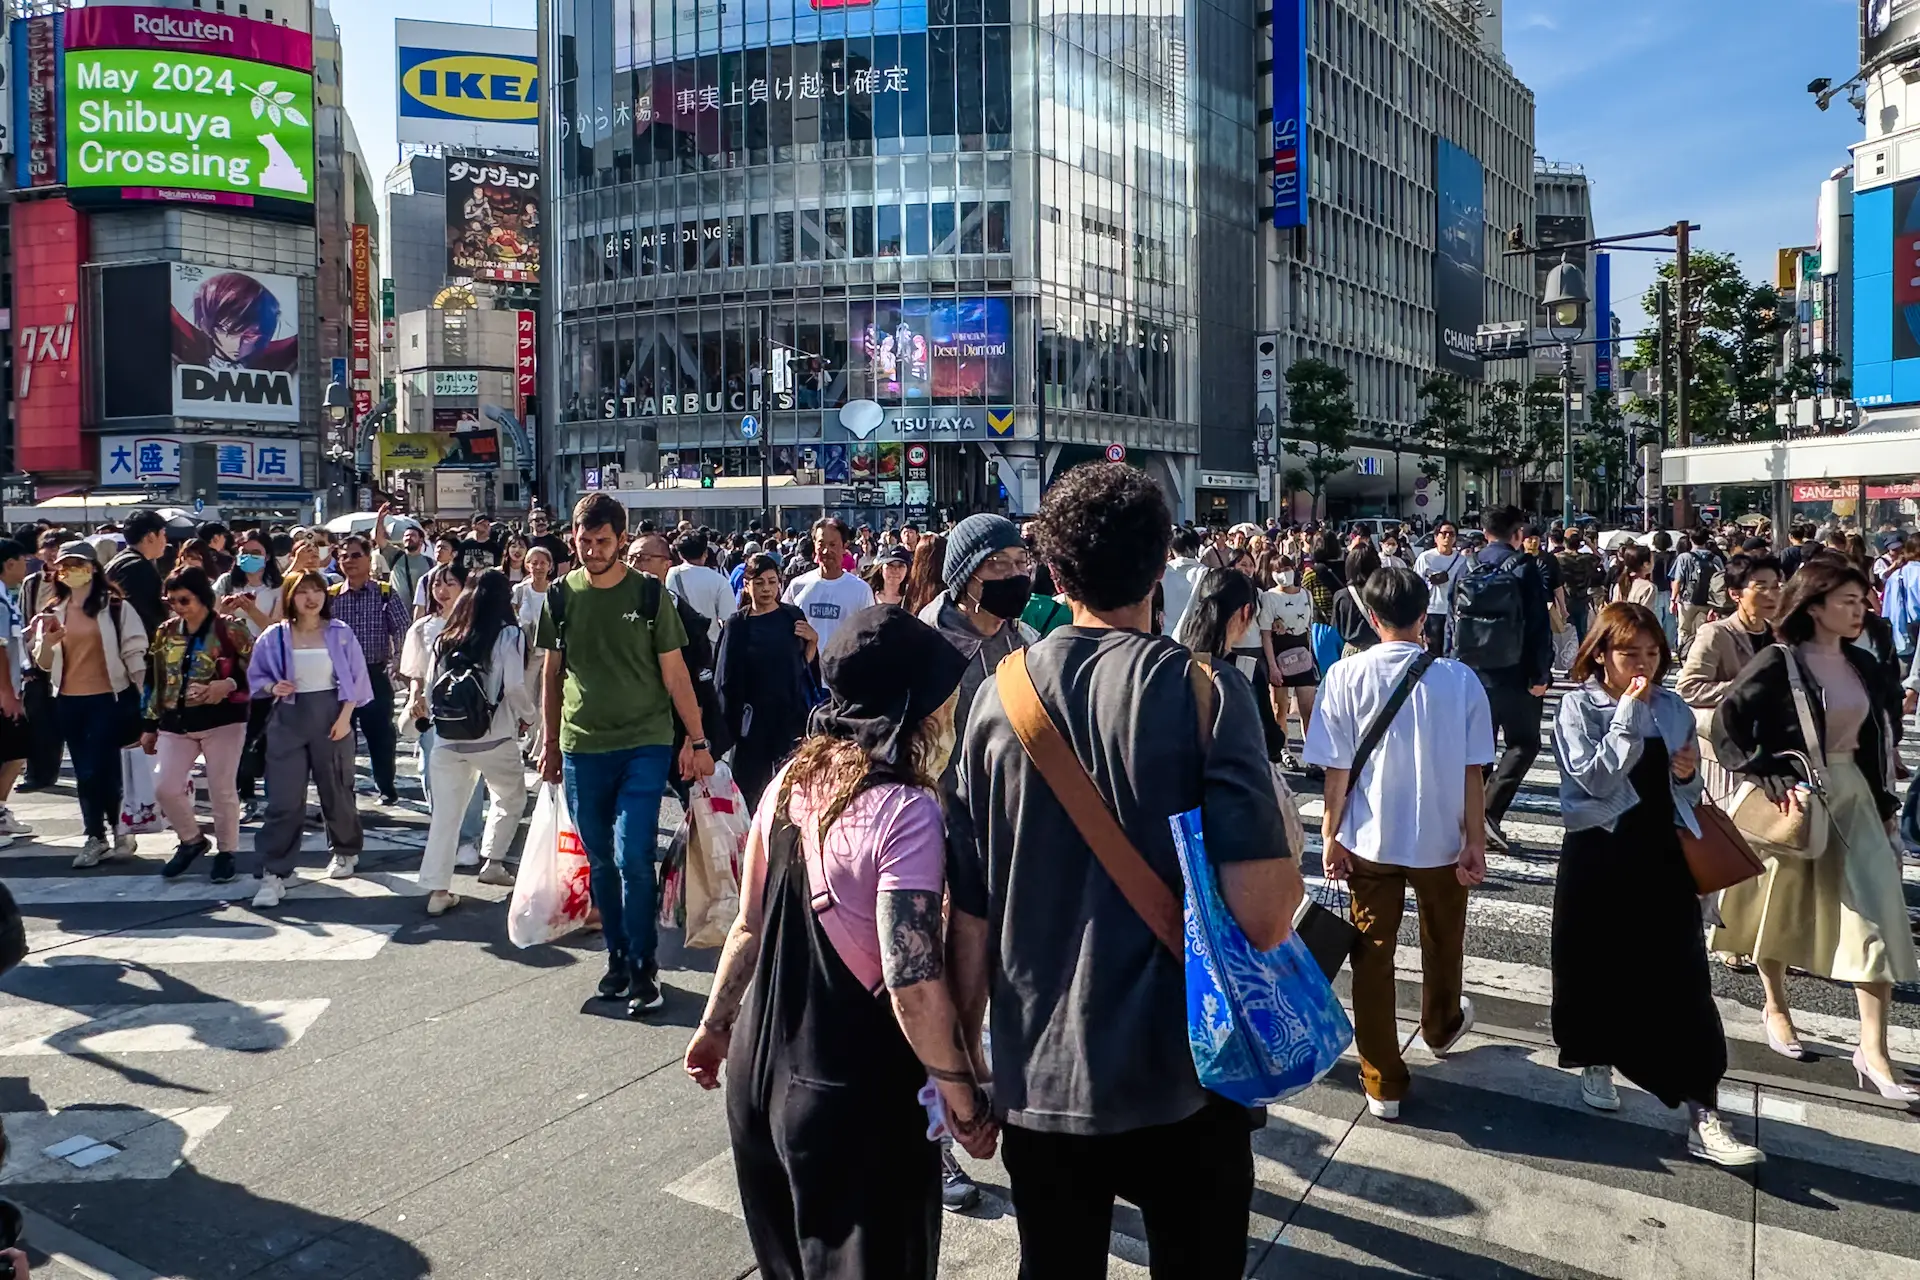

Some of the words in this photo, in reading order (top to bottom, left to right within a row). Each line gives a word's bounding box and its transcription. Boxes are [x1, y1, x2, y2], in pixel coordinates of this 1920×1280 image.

[134, 13, 234, 43] Rakuten
[77, 62, 139, 93] May
[152, 62, 236, 96] 2024
[79, 100, 231, 141] Shibuya
[79, 140, 250, 187] Crossing
[1274, 118, 1297, 208] SEIBU
[158, 188, 190, 200] Rakuten
[191, 190, 216, 202] Vision
[518, 320, 534, 385] カラオケ
[181, 368, 293, 406] DMM
[436, 384, 478, 394] クリニック
[446, 373, 478, 382] れいわ
[893, 417, 976, 432] TSUTAYA
[110, 443, 287, 475] 大盛書店
